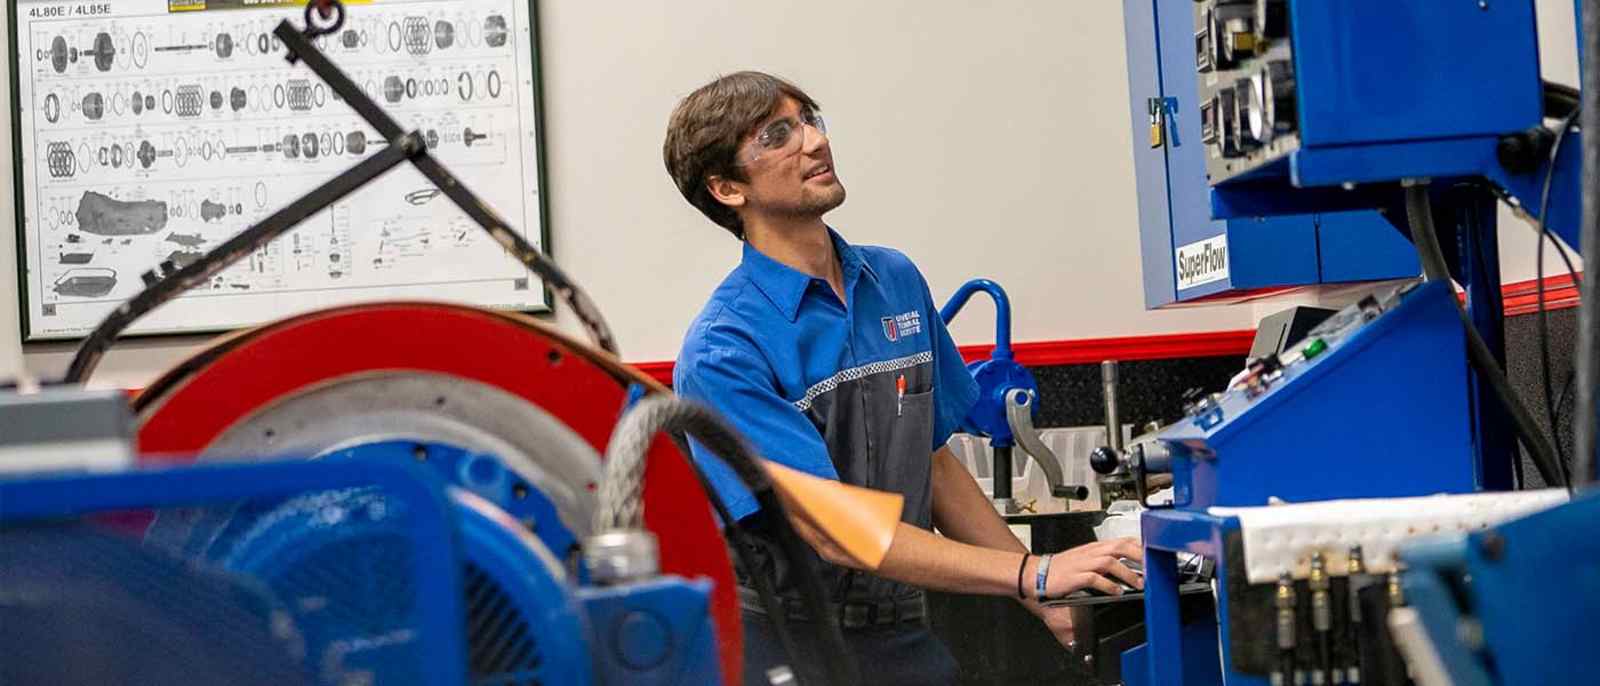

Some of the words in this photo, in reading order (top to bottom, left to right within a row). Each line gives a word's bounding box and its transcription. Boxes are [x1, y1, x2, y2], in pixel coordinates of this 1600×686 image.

[29, 6, 65, 17] 4L80E
[75, 3, 111, 15] 4L85E
[1178, 242, 1226, 285] SuperFlow
